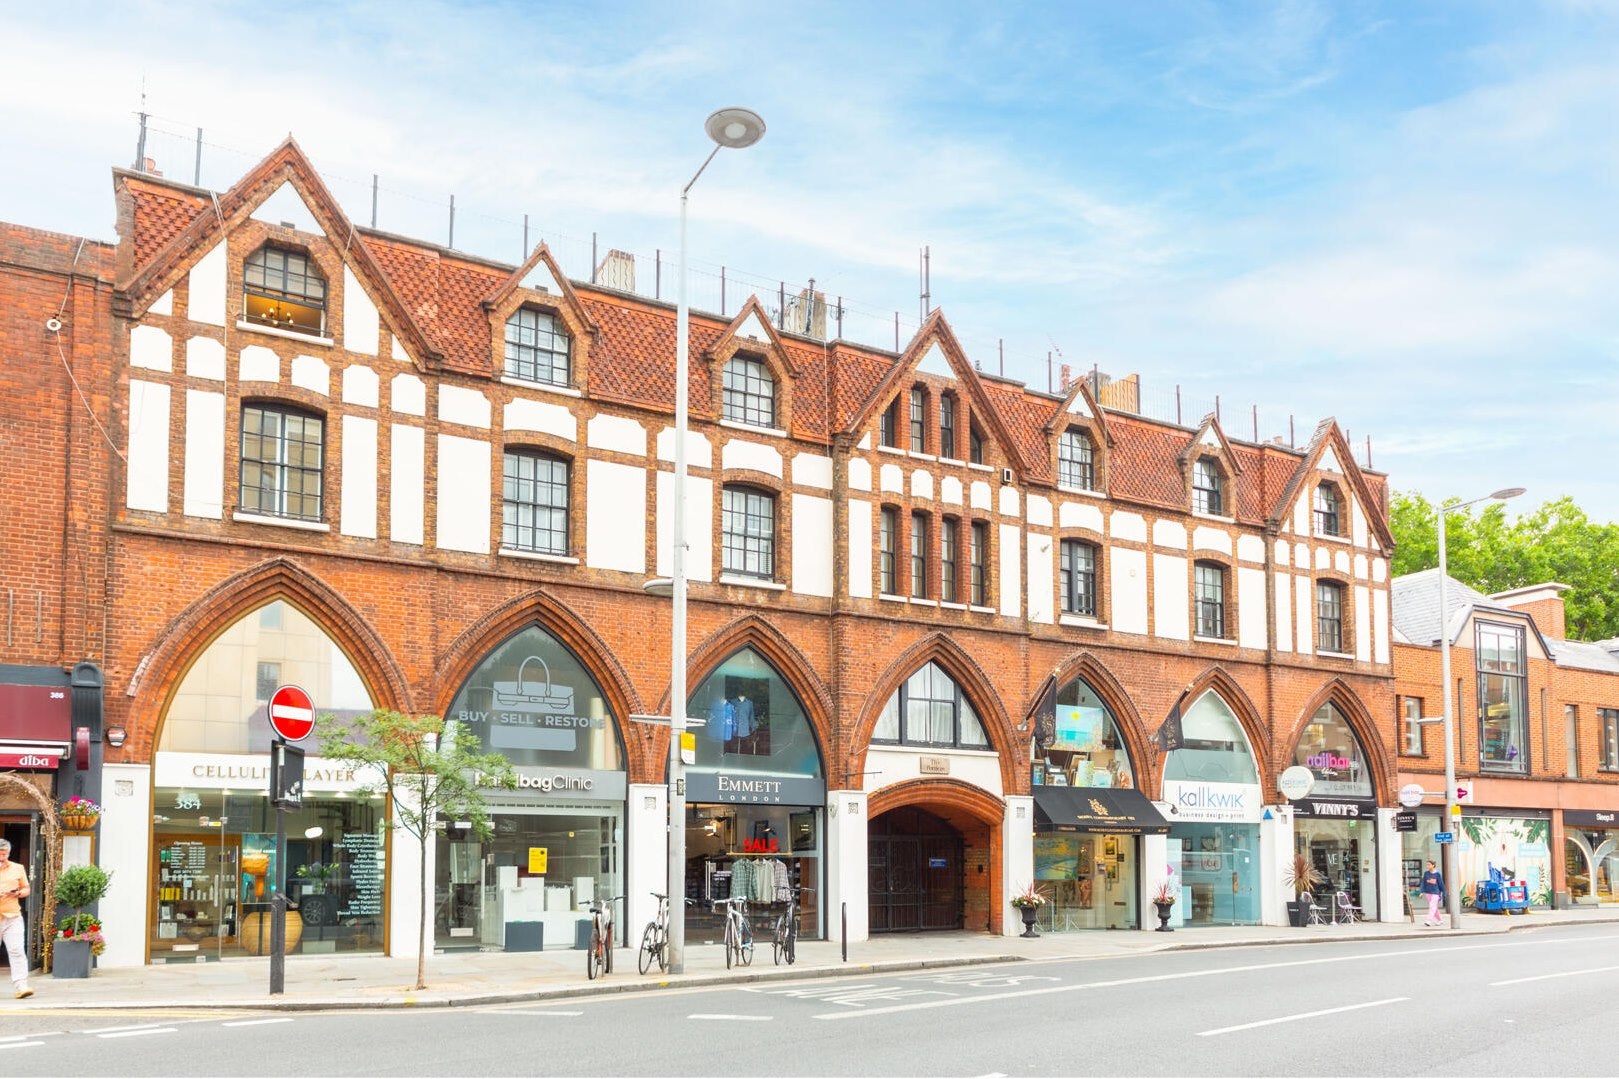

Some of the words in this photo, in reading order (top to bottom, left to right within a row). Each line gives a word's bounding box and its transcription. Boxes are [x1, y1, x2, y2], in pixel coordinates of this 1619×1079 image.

[459, 710, 489, 722] BUY
[500, 713, 534, 725] SELL
[19, 755, 49, 766] diba
[1306, 752, 1351, 769] nailbar
[192, 765, 271, 779] CELLULI
[303, 768, 356, 782] LAYER
[718, 776, 782, 793] EMMETT
[718, 794, 780, 803] LONDON
[1312, 803, 1359, 816] VINNY'S
[743, 837, 780, 853] SALE
